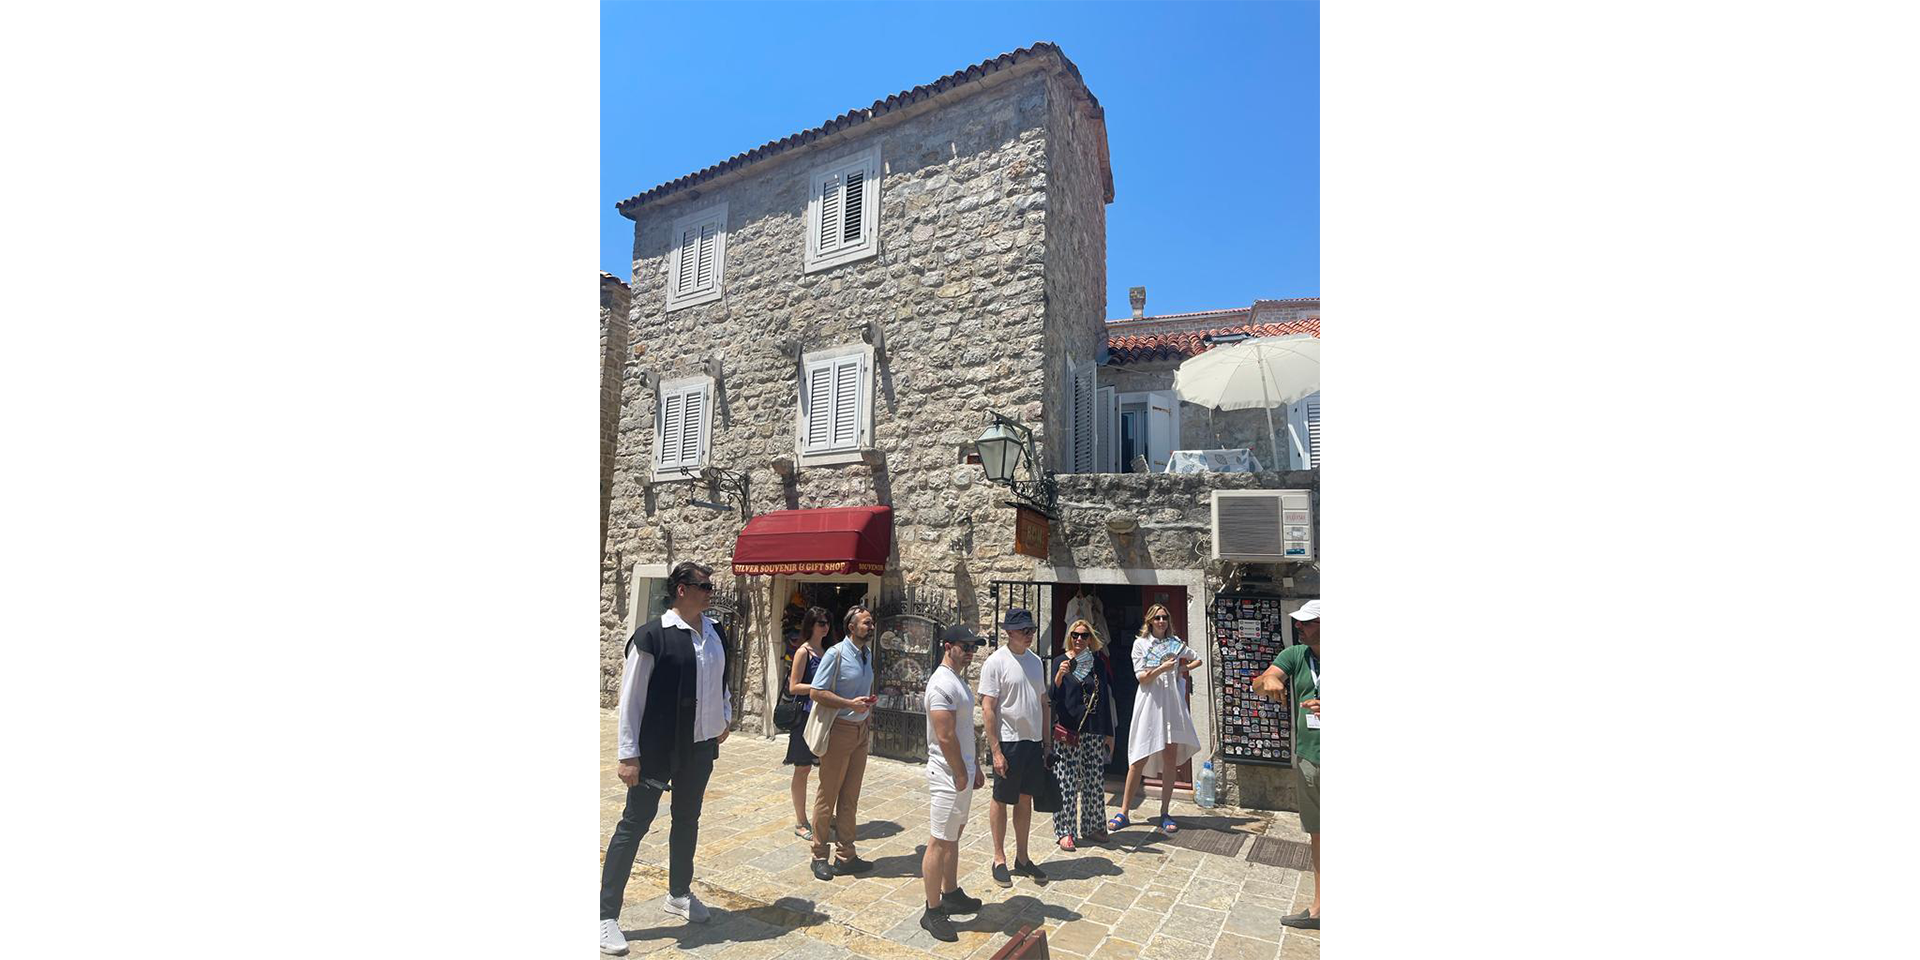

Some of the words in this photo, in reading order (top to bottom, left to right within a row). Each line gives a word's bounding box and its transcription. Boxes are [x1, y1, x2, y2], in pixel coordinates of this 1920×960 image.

[735, 564, 759, 573] SILVER
[760, 563, 797, 573] SOUVENIR
[798, 563, 805, 571] &
[806, 562, 824, 572] GIFT
[824, 562, 846, 571] SHOP
